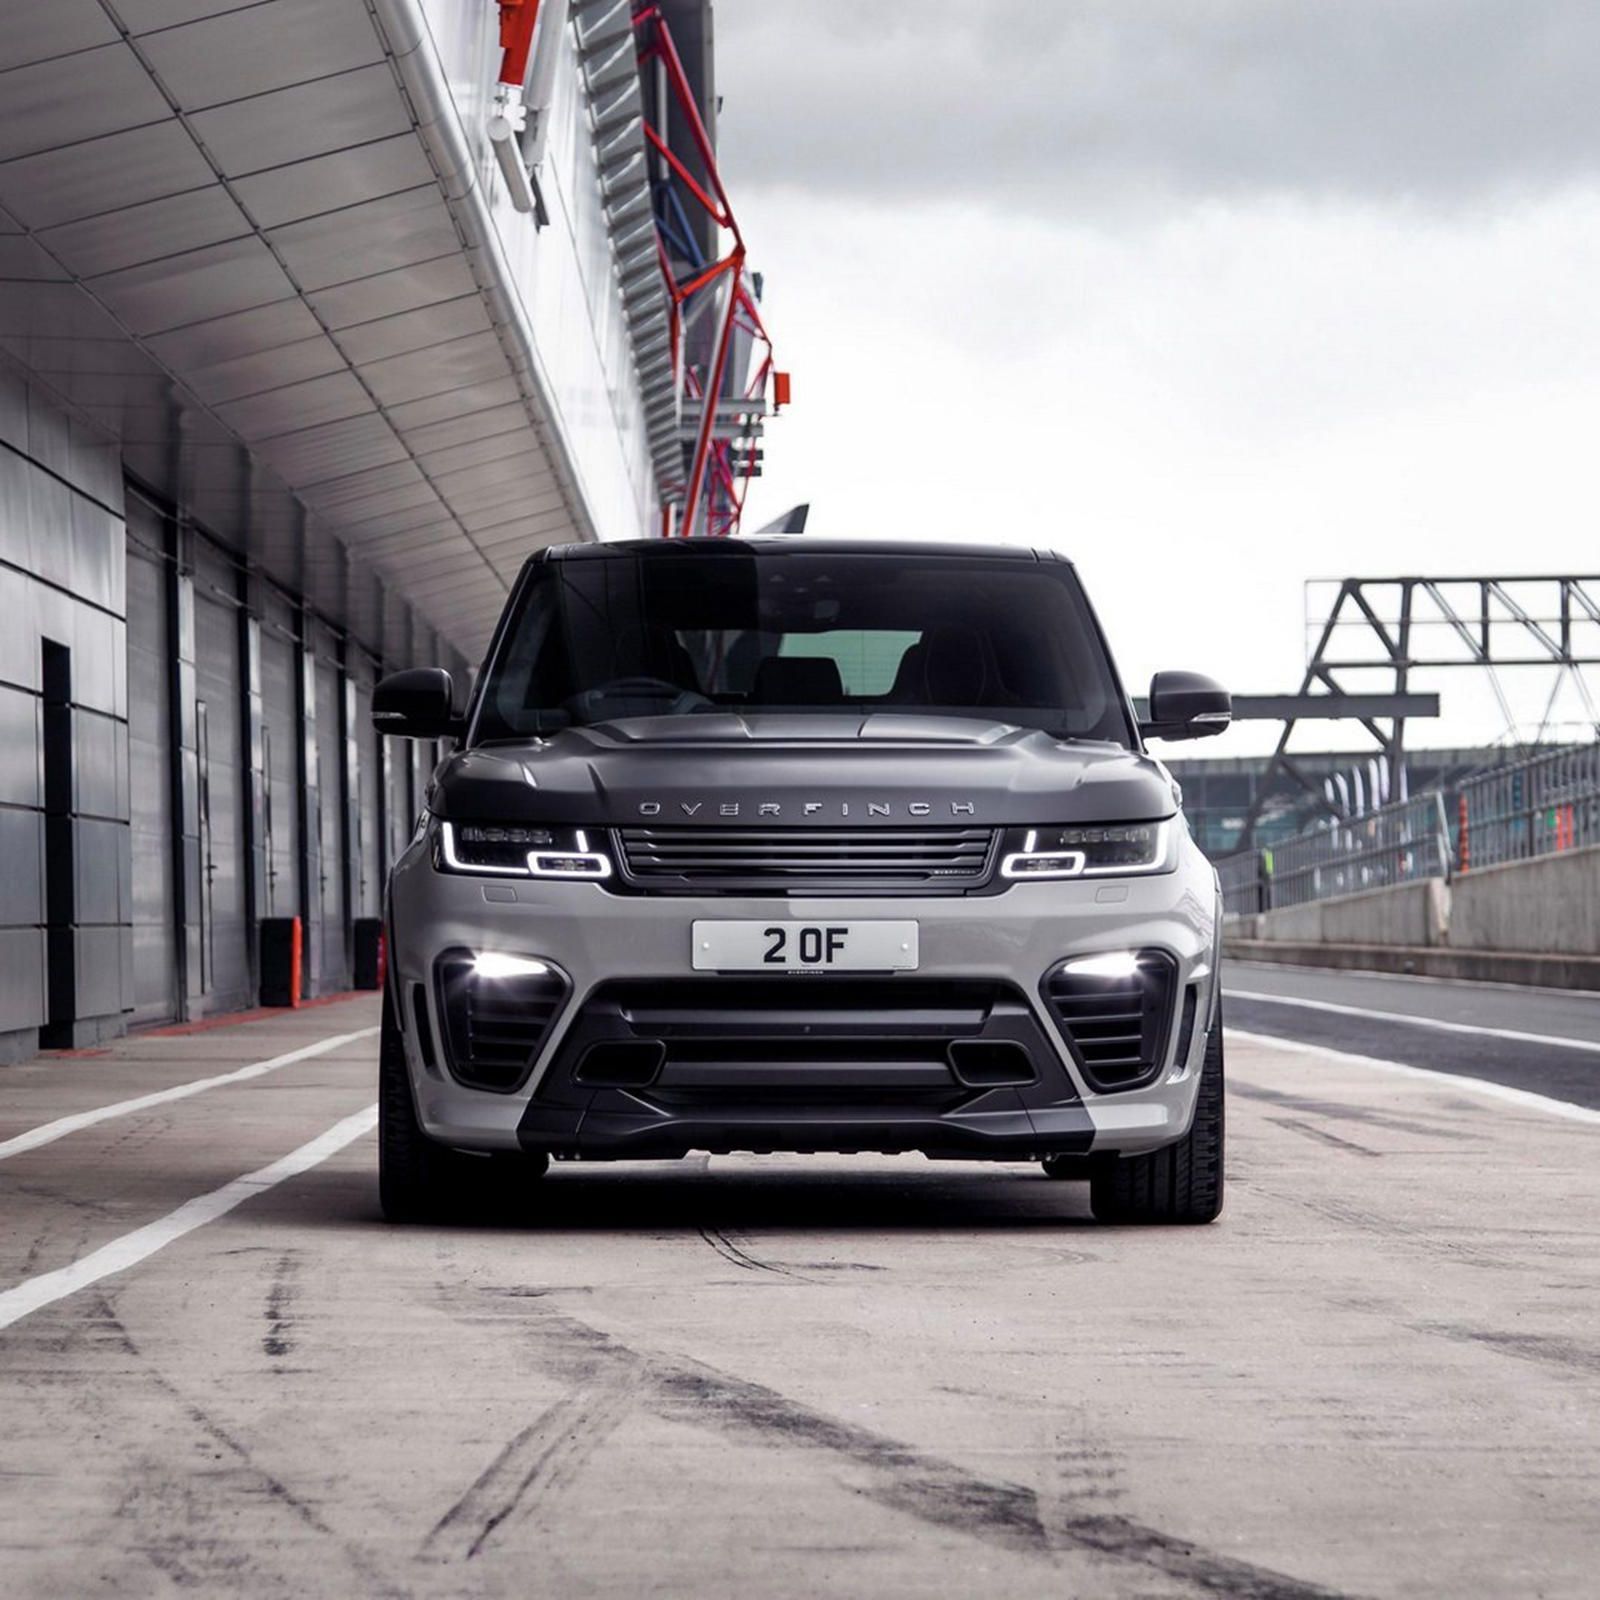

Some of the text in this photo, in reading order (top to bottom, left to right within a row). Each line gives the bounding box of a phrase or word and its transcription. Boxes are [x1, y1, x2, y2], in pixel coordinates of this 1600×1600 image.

[638, 802, 976, 816] OVERFINCH
[763, 927, 848, 962] 2 OF
